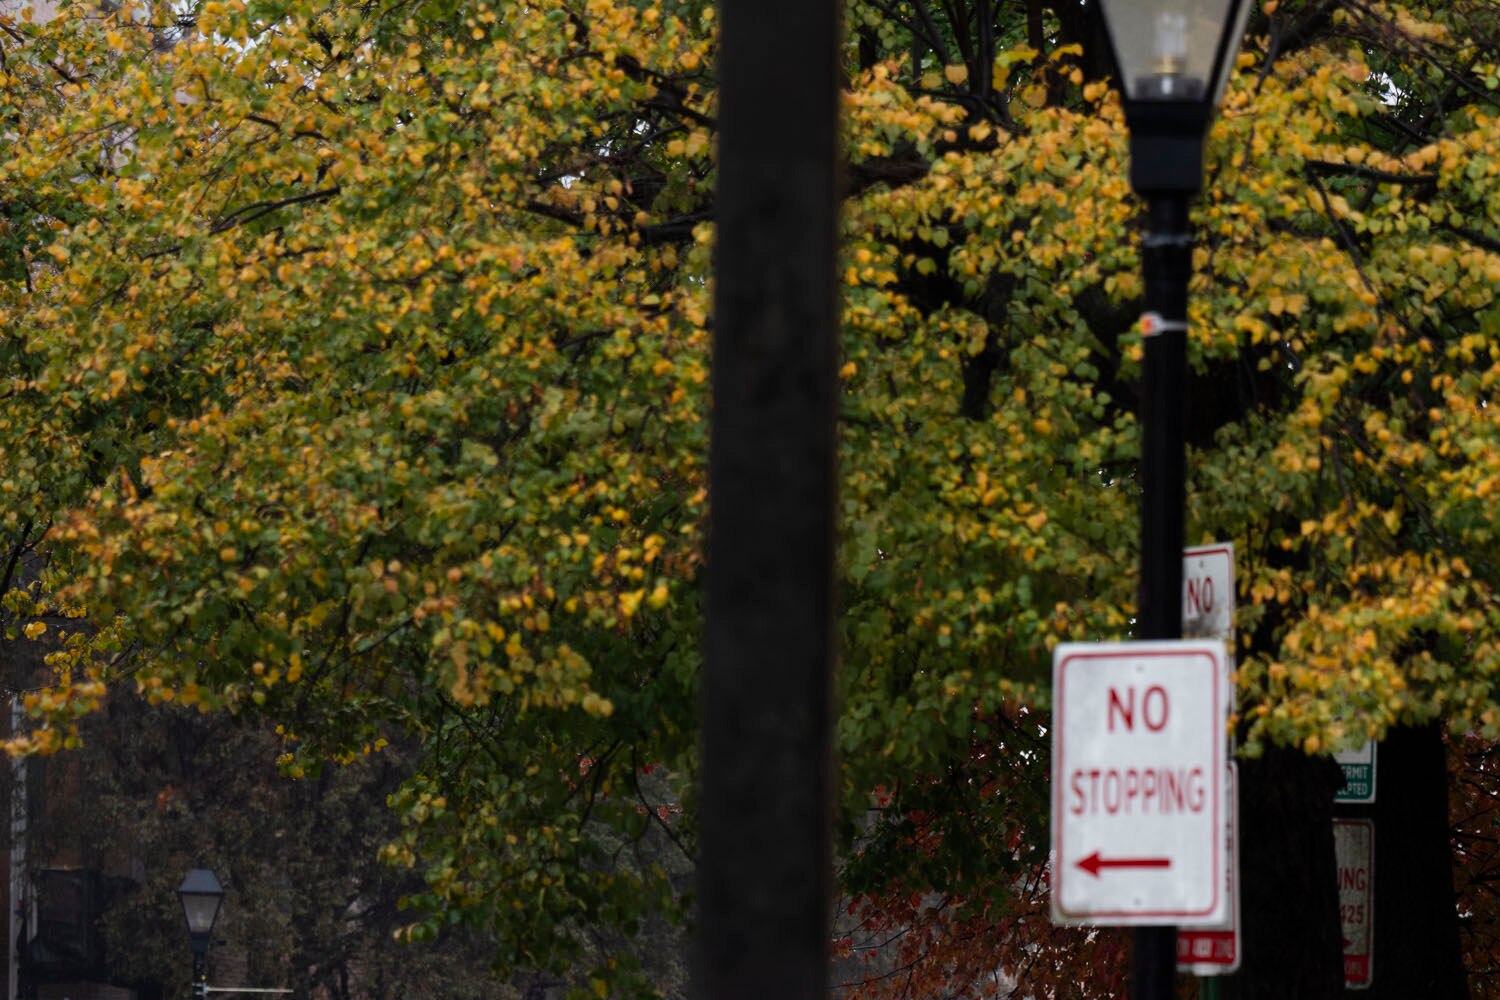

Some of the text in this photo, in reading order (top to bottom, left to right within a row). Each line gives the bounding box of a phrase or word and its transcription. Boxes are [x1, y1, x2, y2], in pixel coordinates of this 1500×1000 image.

[1187, 576, 1214, 615] NO
[1107, 684, 1170, 733] NO
[1070, 767, 1205, 816] STOPPING
